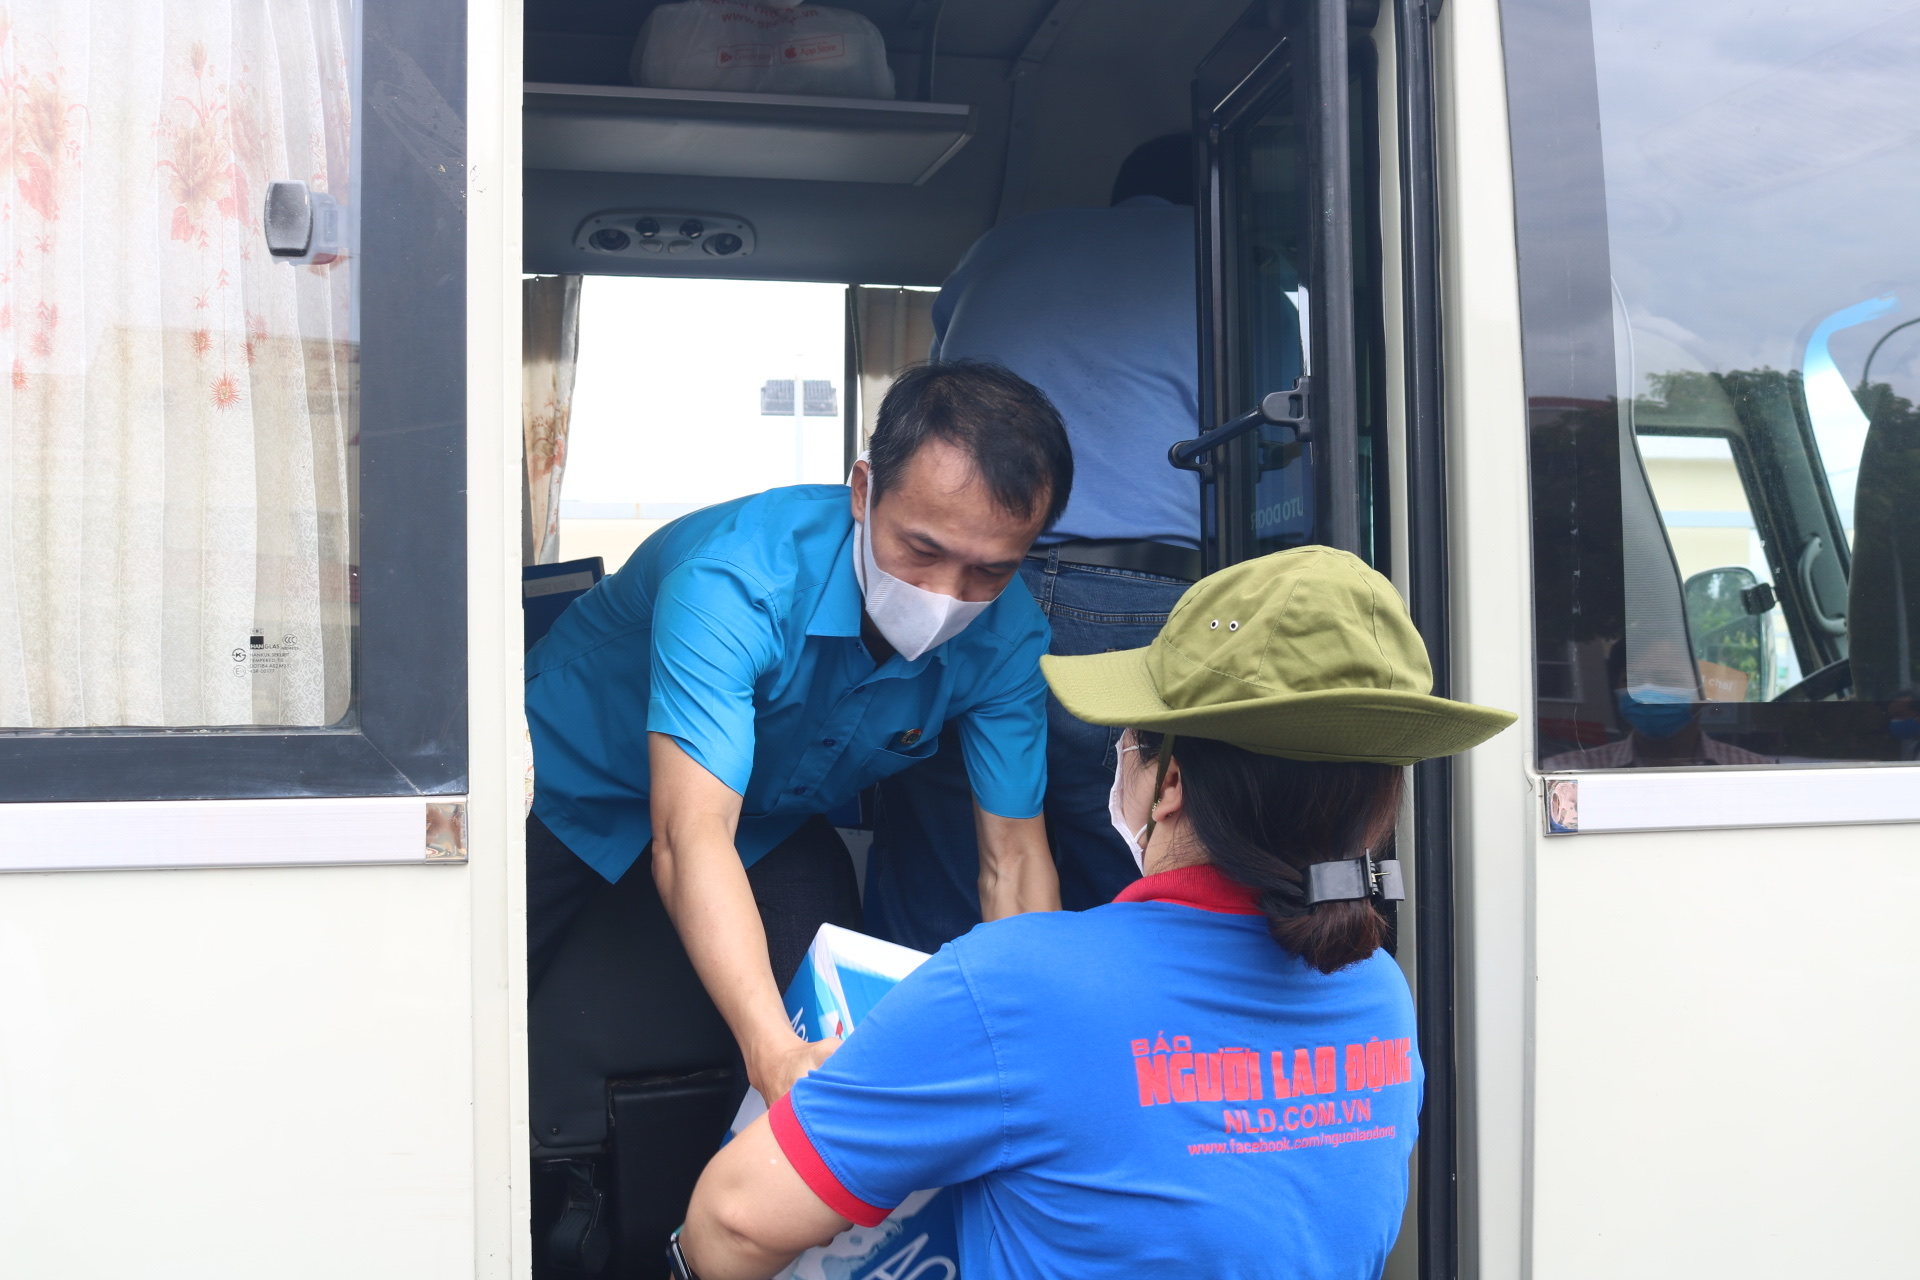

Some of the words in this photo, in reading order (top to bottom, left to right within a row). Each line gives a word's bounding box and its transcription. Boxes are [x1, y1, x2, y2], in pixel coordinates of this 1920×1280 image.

[1131, 1030, 1192, 1057] BÁO
[1135, 1047, 1263, 1107] NGƯỜI
[1271, 1046, 1336, 1100] LAO
[1344, 1037, 1412, 1093] ĐỘNG
[1223, 1098, 1371, 1134] NLD.COM.VN
[1187, 1124, 1396, 1156] www.facebook.com/nguoilaodong
